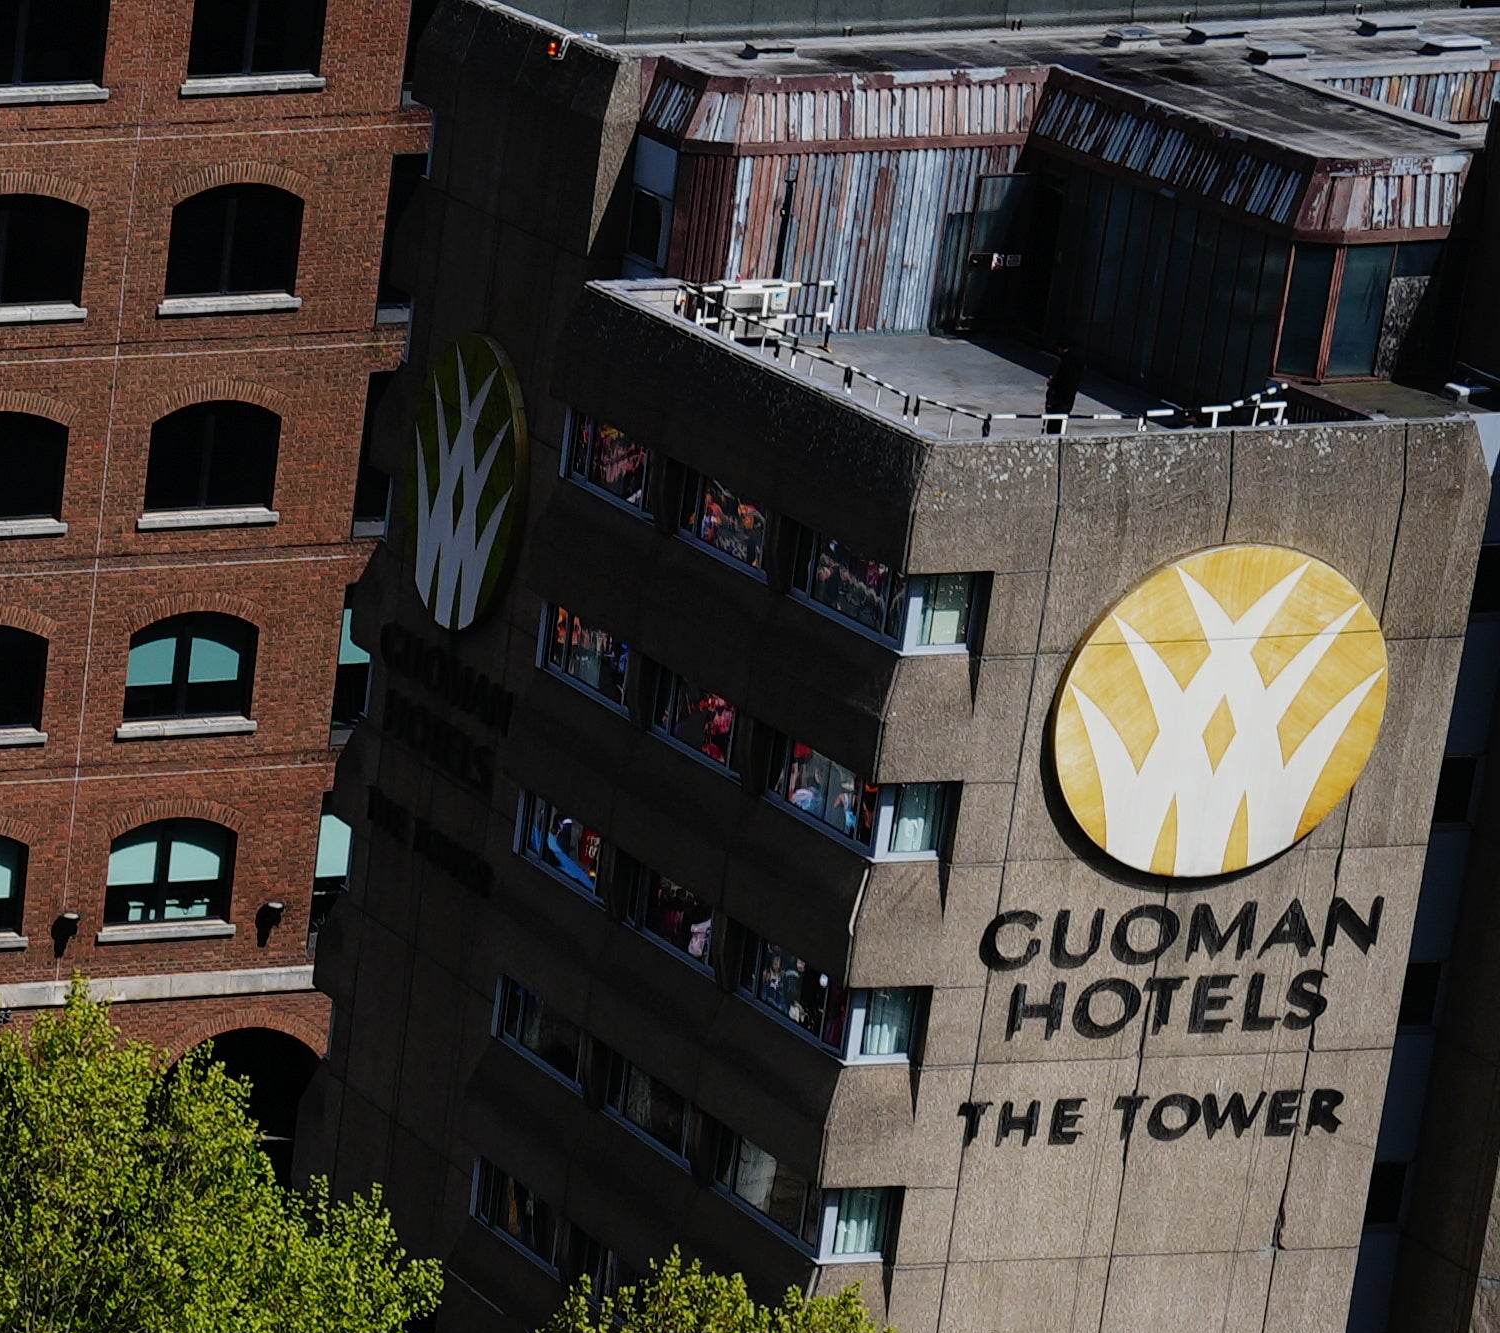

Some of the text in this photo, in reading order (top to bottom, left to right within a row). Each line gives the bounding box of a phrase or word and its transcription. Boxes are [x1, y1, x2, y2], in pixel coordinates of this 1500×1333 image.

[979, 894, 1386, 971] GUOMAN
[1004, 970, 1328, 1041] HOTELS
[957, 1088, 1345, 1149] THE TOWER
